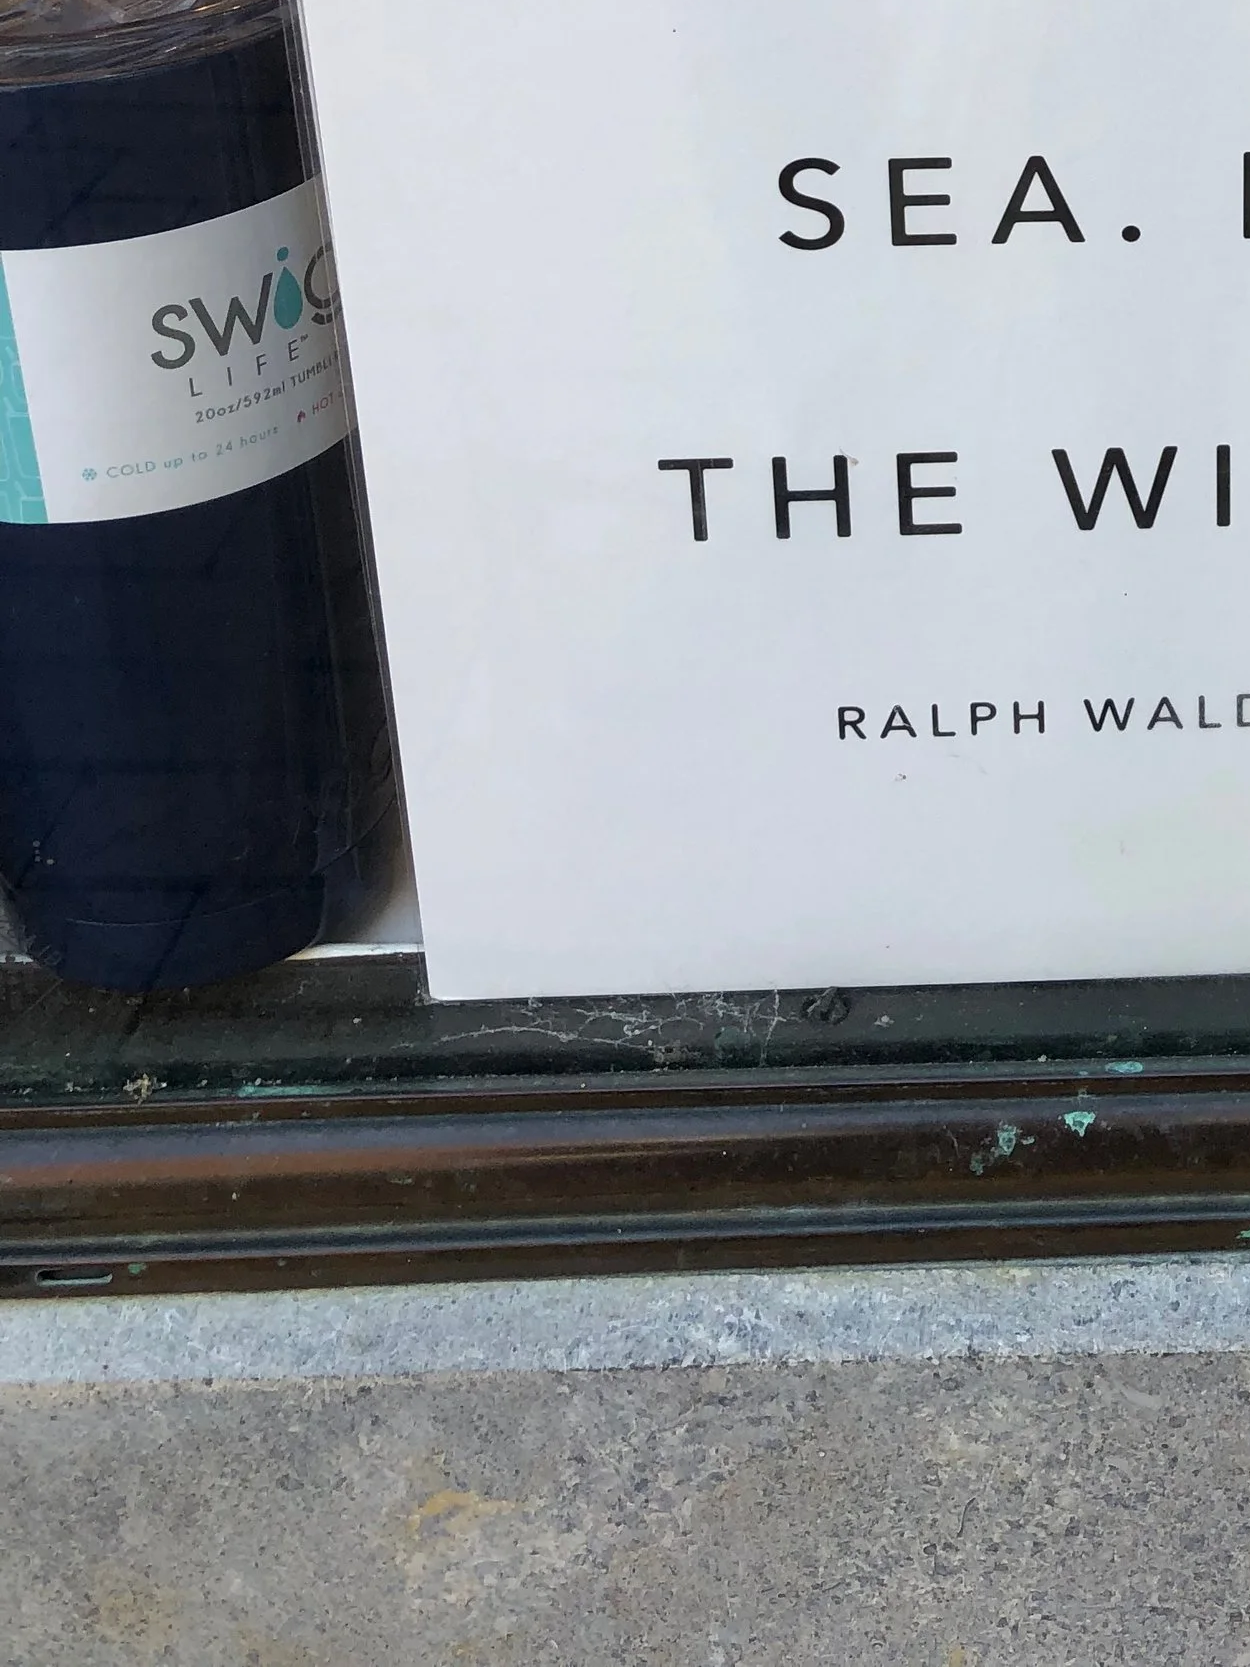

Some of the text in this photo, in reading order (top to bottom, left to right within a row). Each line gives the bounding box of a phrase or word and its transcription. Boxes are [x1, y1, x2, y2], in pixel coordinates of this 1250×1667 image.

[777, 155, 1142, 251] SEA.
[106, 424, 280, 480] COLD up to 24 hours
[657, 451, 963, 542] THE
[837, 700, 1046, 741] RALPH
